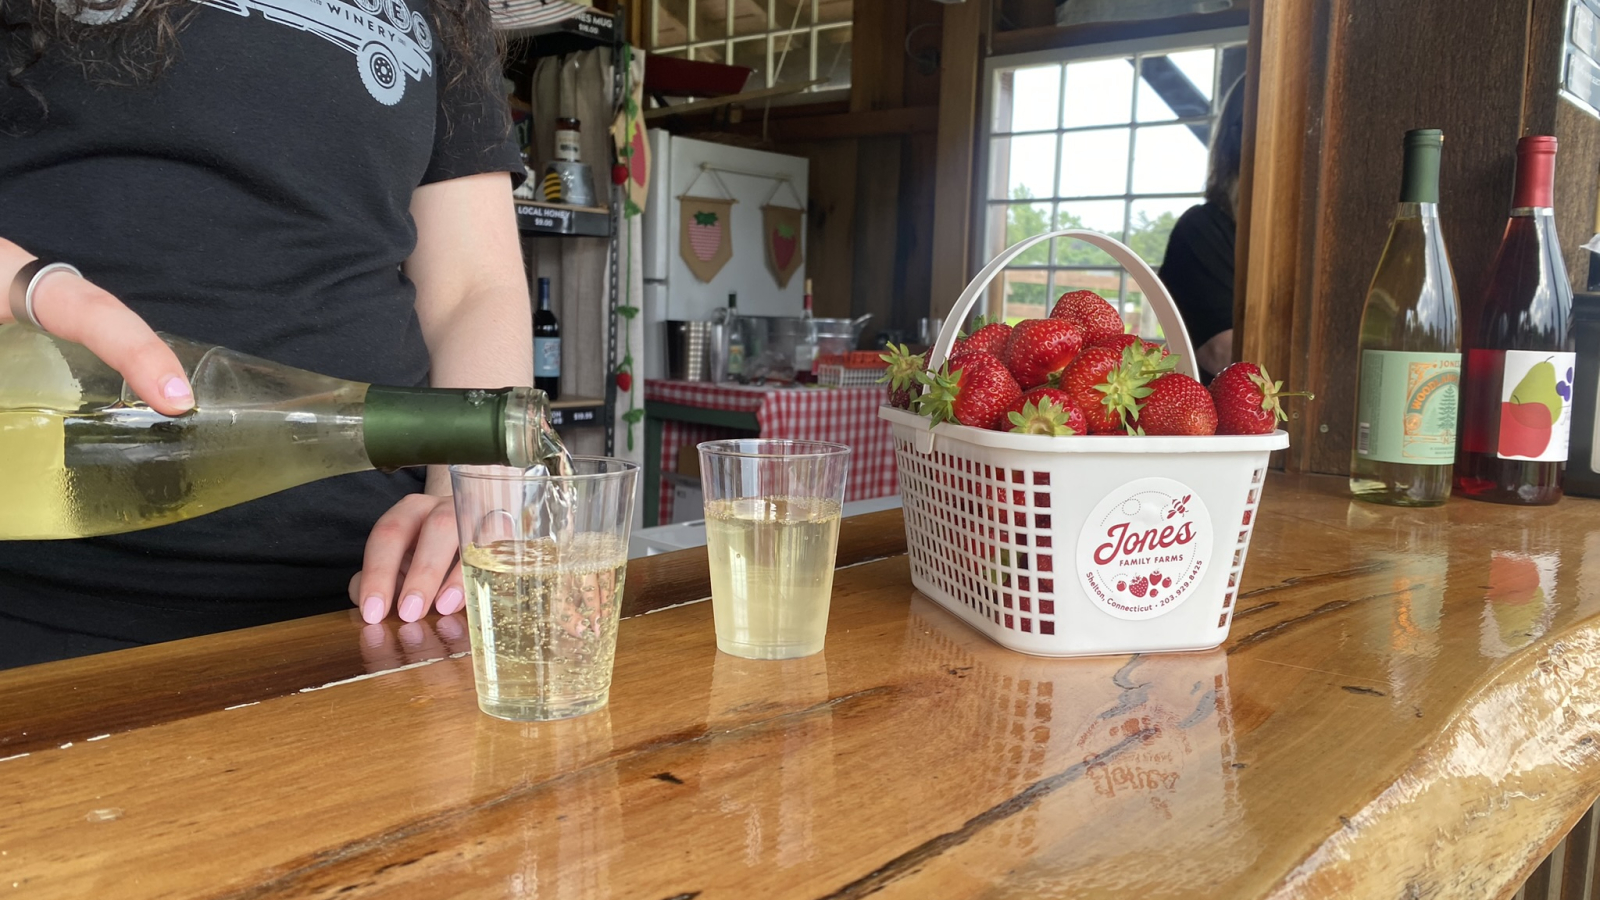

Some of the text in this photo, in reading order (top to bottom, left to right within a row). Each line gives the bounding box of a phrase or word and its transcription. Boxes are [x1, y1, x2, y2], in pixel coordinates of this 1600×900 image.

[327, 2, 395, 42] WINERY
[592, 16, 613, 28] MUG
[518, 206, 570, 219] LOCAL HONEY
[1093, 521, 1197, 566] Jones
[1119, 554, 1184, 567] FAMILY FARMS
[1086, 560, 1203, 613] Shelton, Connecticut 203.929.8425
